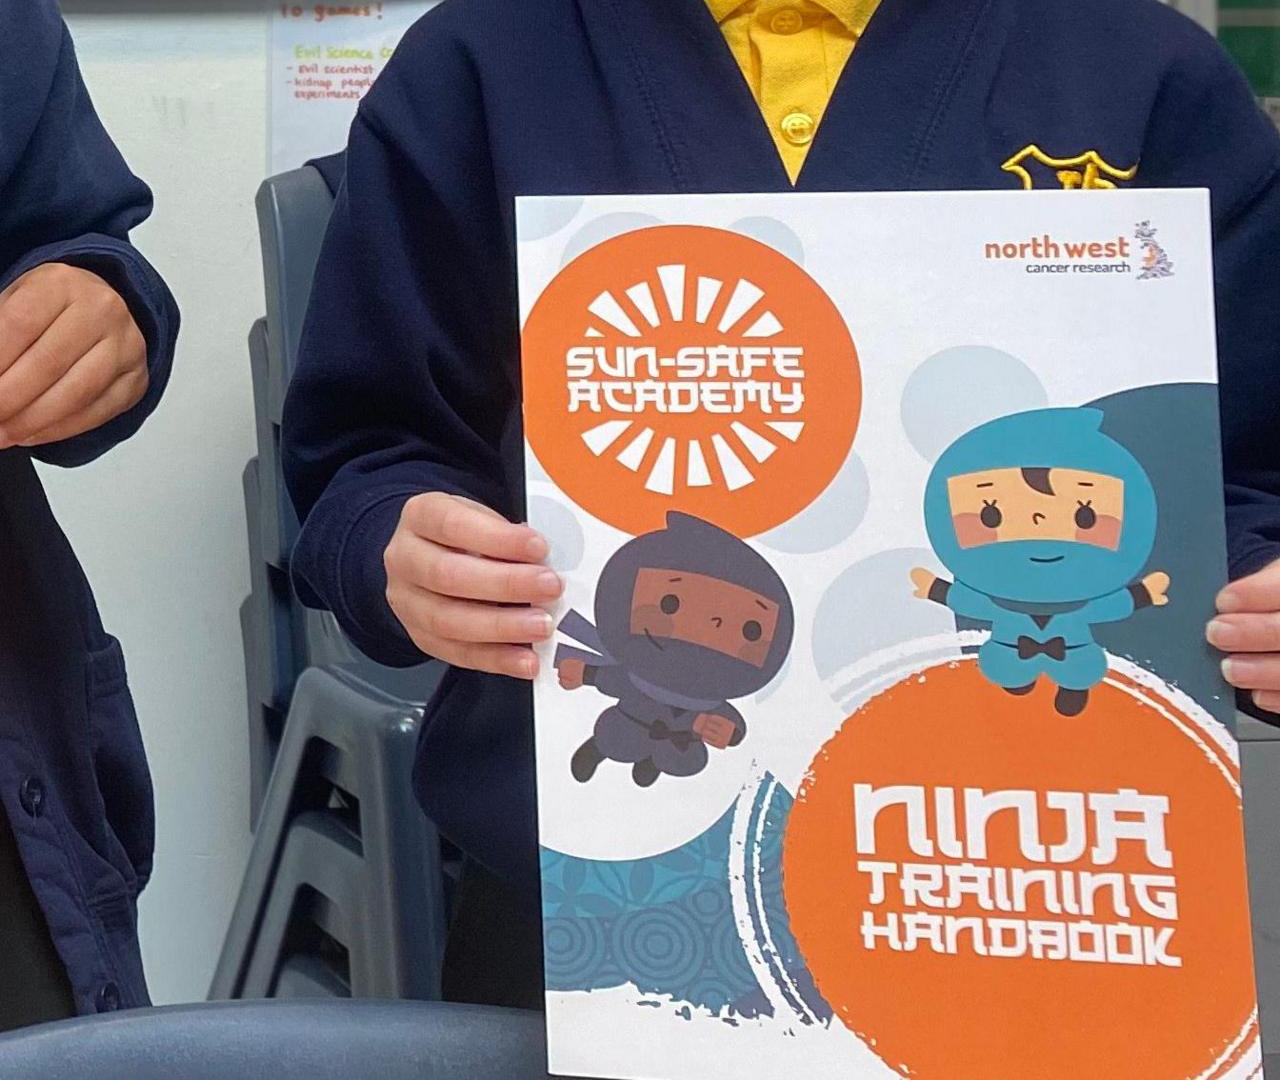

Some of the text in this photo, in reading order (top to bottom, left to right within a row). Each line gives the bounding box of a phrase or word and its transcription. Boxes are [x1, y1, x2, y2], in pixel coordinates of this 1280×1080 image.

[985, 234, 1130, 258] north west
[1026, 261, 1131, 273] cancer research
[565, 344, 805, 380] SUN-SAFE
[567, 379, 805, 414] ACADEMY
[852, 783, 1174, 869] NINJA
[856, 860, 1179, 921] TRAINING
[860, 911, 1183, 968] HANDBOOK
